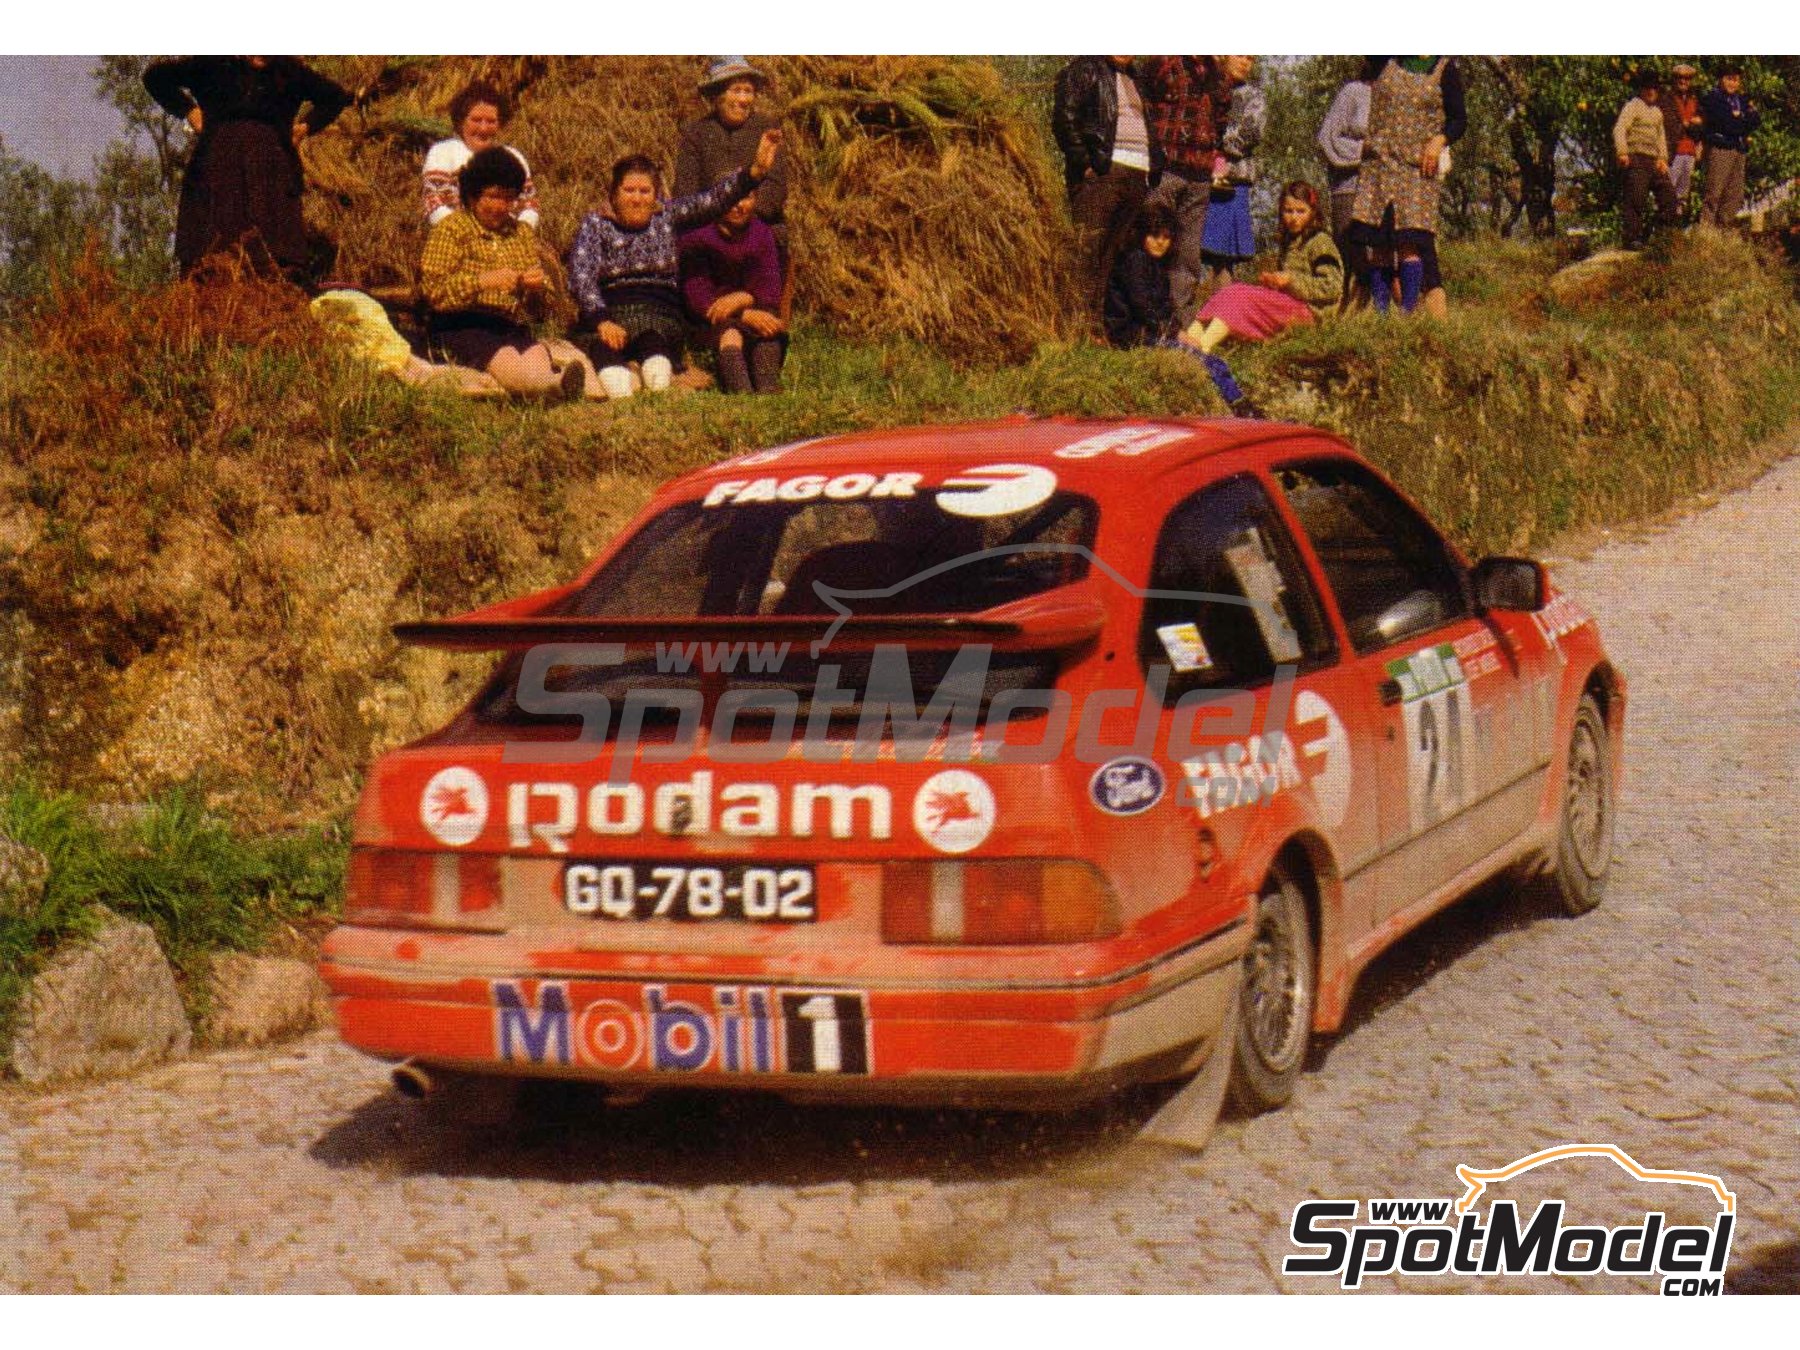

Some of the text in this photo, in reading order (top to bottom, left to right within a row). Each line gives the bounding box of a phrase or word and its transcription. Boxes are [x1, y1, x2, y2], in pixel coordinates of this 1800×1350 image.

[703, 472, 924, 506] FAGOR
[565, 865, 814, 919] GQ-78-02
[491, 981, 844, 1073] Mobil 1
